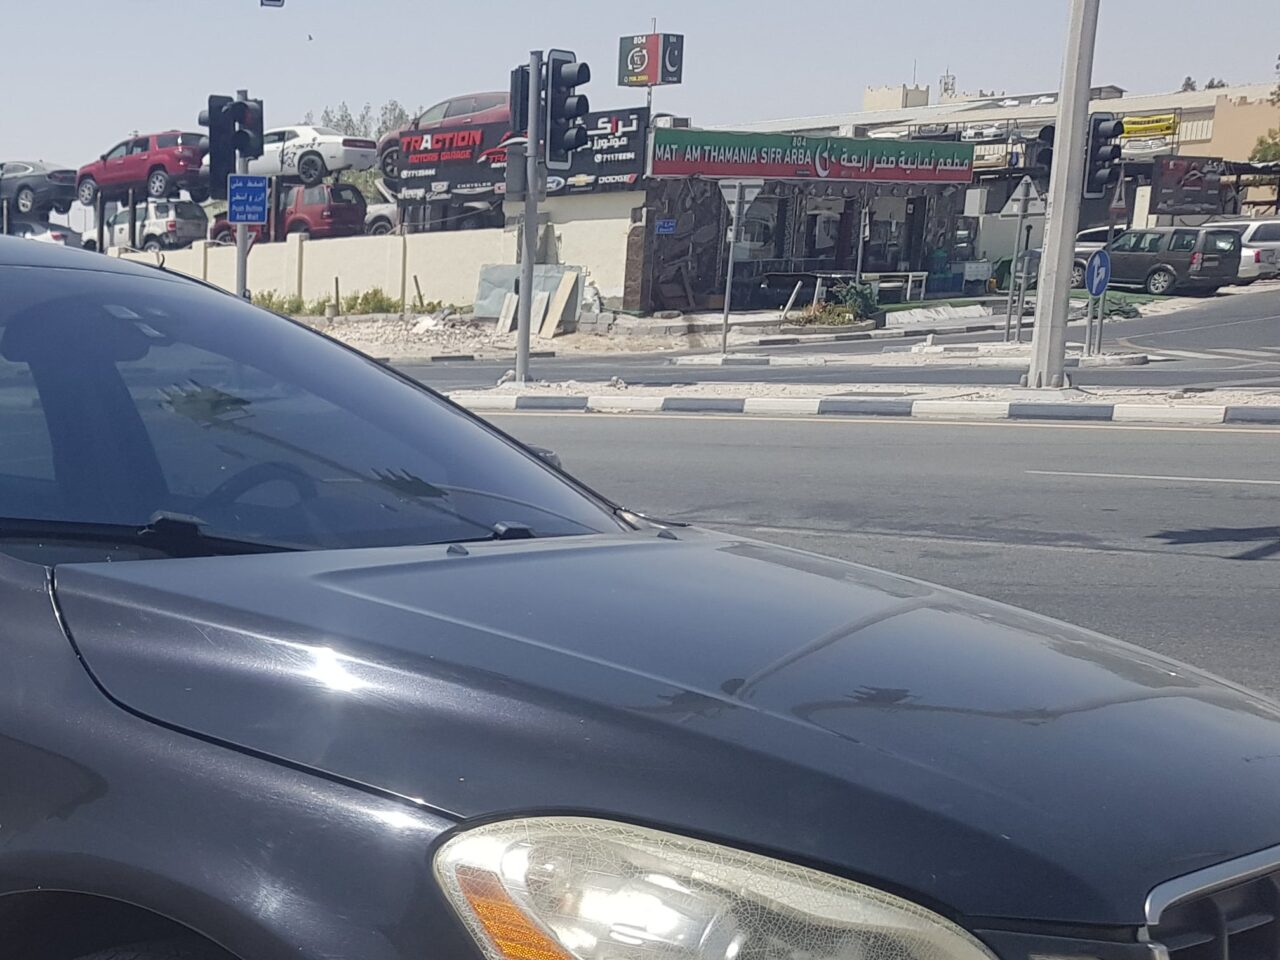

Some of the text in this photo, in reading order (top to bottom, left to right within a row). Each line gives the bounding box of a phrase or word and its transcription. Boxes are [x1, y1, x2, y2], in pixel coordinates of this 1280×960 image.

[400, 129, 483, 152] TRACTION
[792, 137, 806, 147] 804
[655, 144, 812, 165] MAT AM THAMANIA SIFR ARBA
[871, 152, 896, 172] صفر
[898, 148, 935, 174] ثمانية
[936, 152, 968, 174] مطعم
[456, 181, 492, 189] CHRYSLER
[598, 174, 628, 184] DODGE
